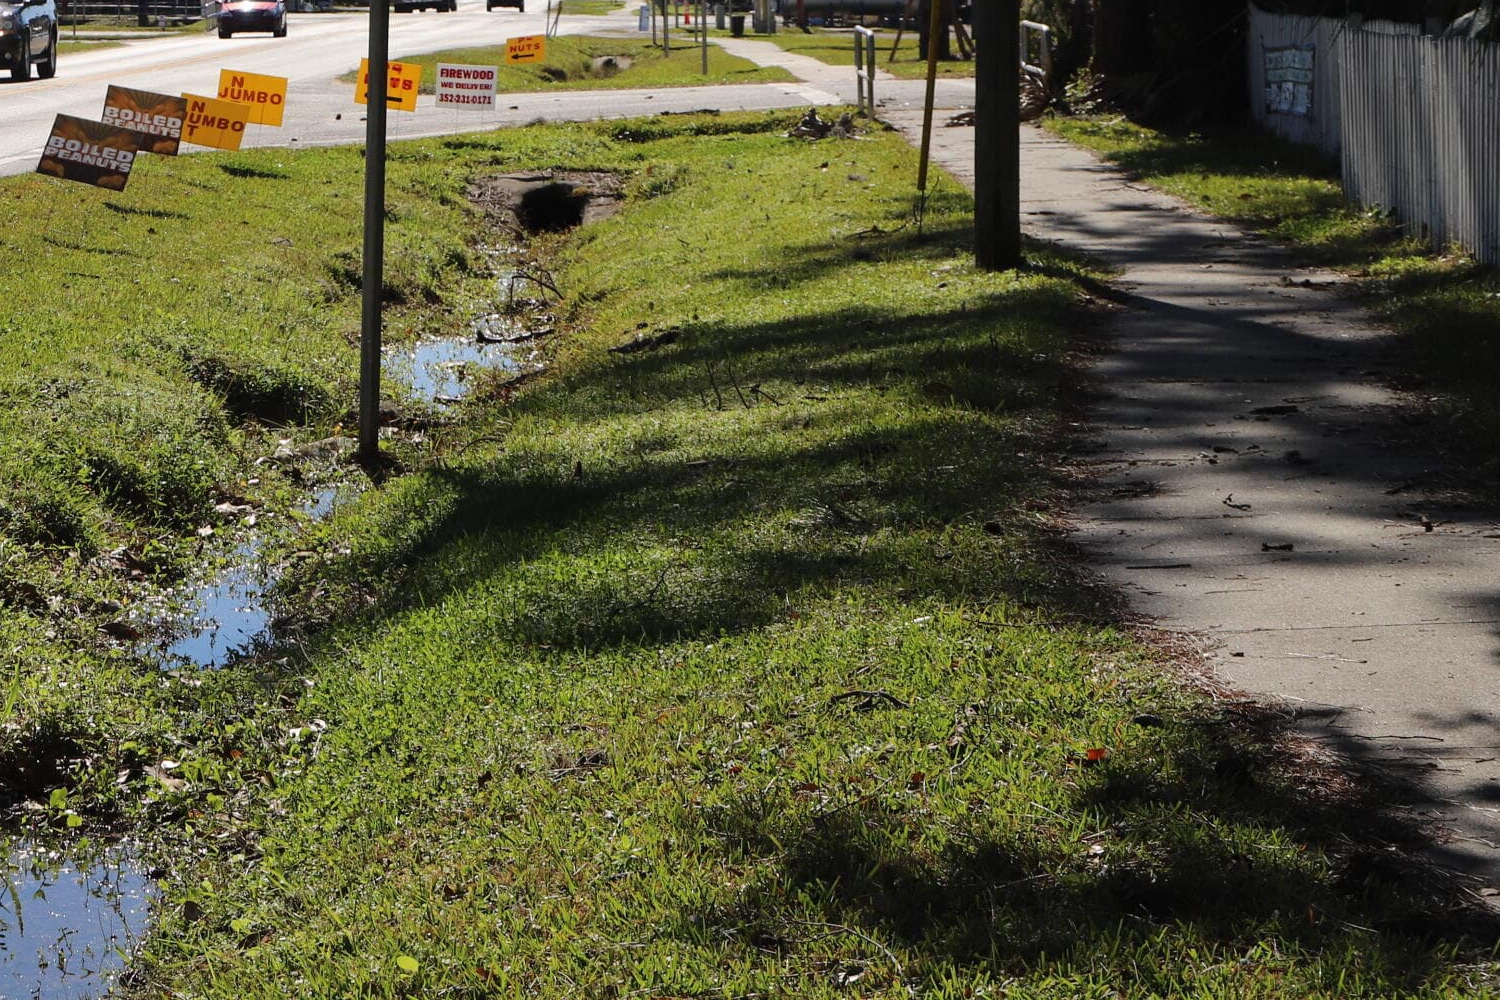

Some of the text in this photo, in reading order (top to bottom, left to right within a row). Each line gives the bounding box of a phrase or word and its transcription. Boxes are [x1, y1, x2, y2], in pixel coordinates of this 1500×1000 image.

[509, 43, 541, 53] NUTS
[440, 68, 494, 80] FIREWOOD
[455, 82, 492, 91] DELIVER!
[219, 87, 282, 105] JUMBO
[438, 93, 492, 105] 352-231-0171
[104, 106, 182, 129] BOILED
[102, 116, 181, 139] PEANUTS
[48, 136, 134, 163] BOILED
[44, 147, 131, 173] PEANUTS
